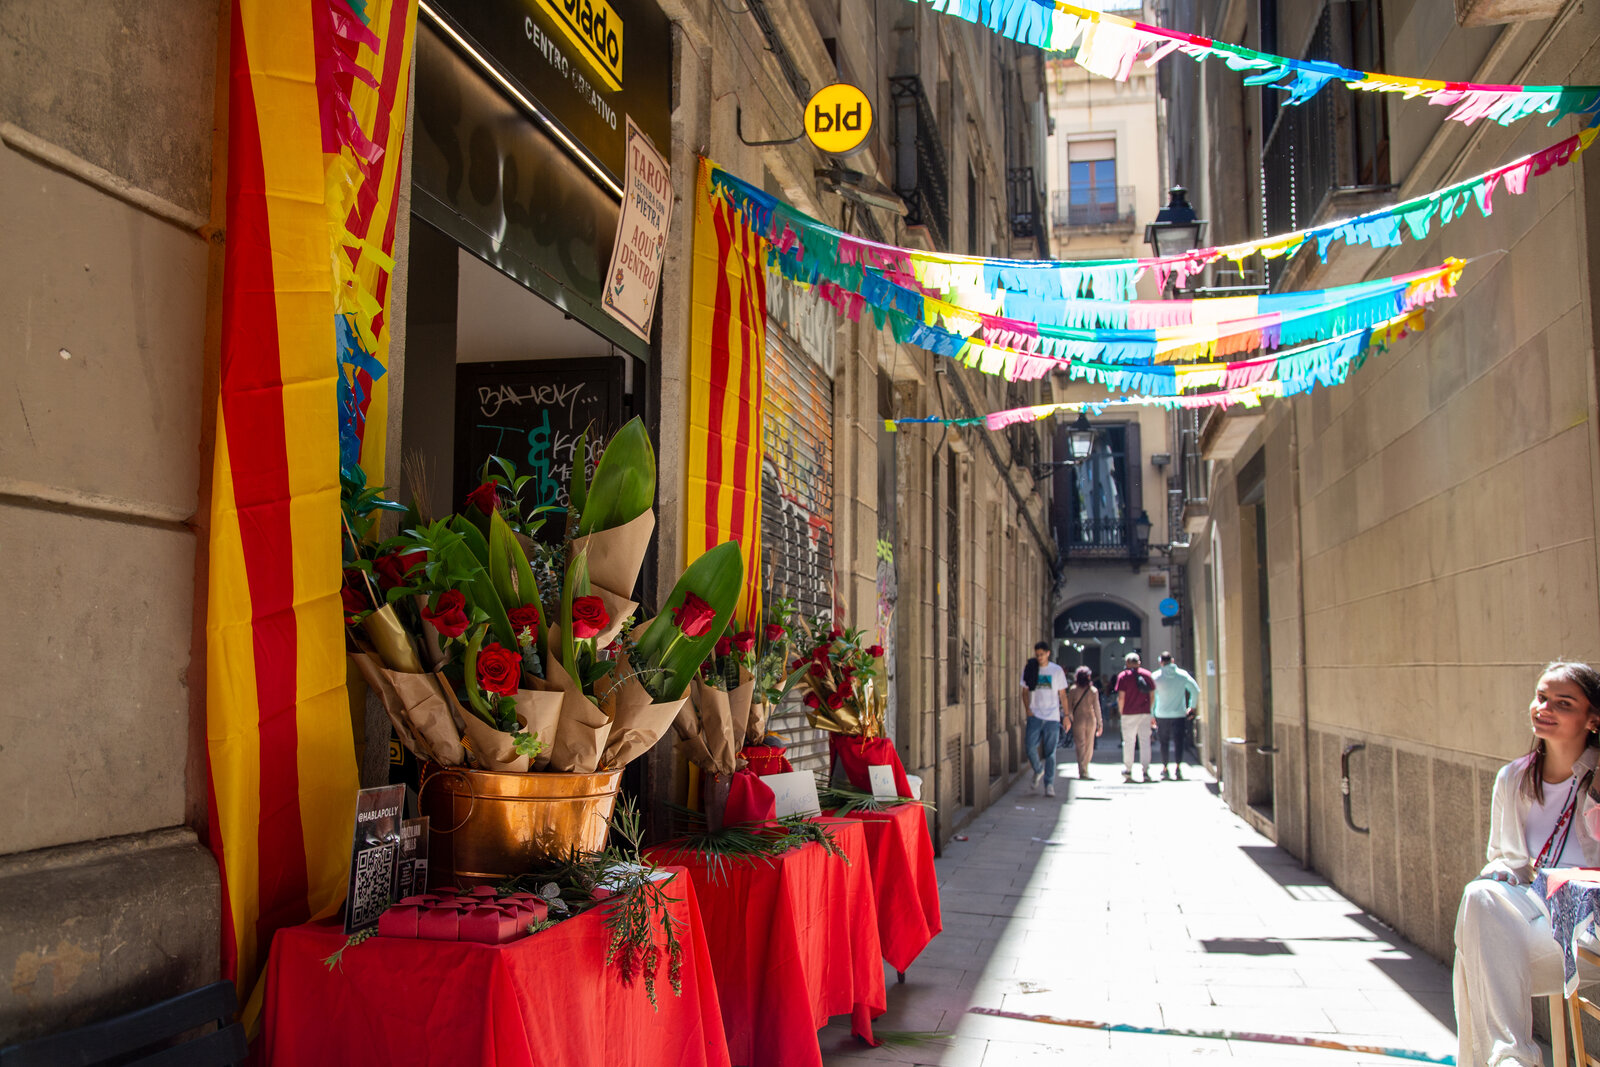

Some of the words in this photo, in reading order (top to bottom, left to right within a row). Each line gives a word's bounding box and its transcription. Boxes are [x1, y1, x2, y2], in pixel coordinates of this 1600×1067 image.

[525, 16, 568, 78] CENTRO
[815, 102, 861, 132] bld
[632, 145, 669, 200] TAROT
[634, 175, 656, 207] LECTURA
[656, 199, 665, 216] CON
[636, 193, 660, 231] PIETRA
[631, 224, 656, 262] AQUÍ
[620, 243, 656, 290] DENTRO
[1065, 618, 1130, 634] Ayestaran
[358, 806, 398, 822] @HABLAPOLLY
